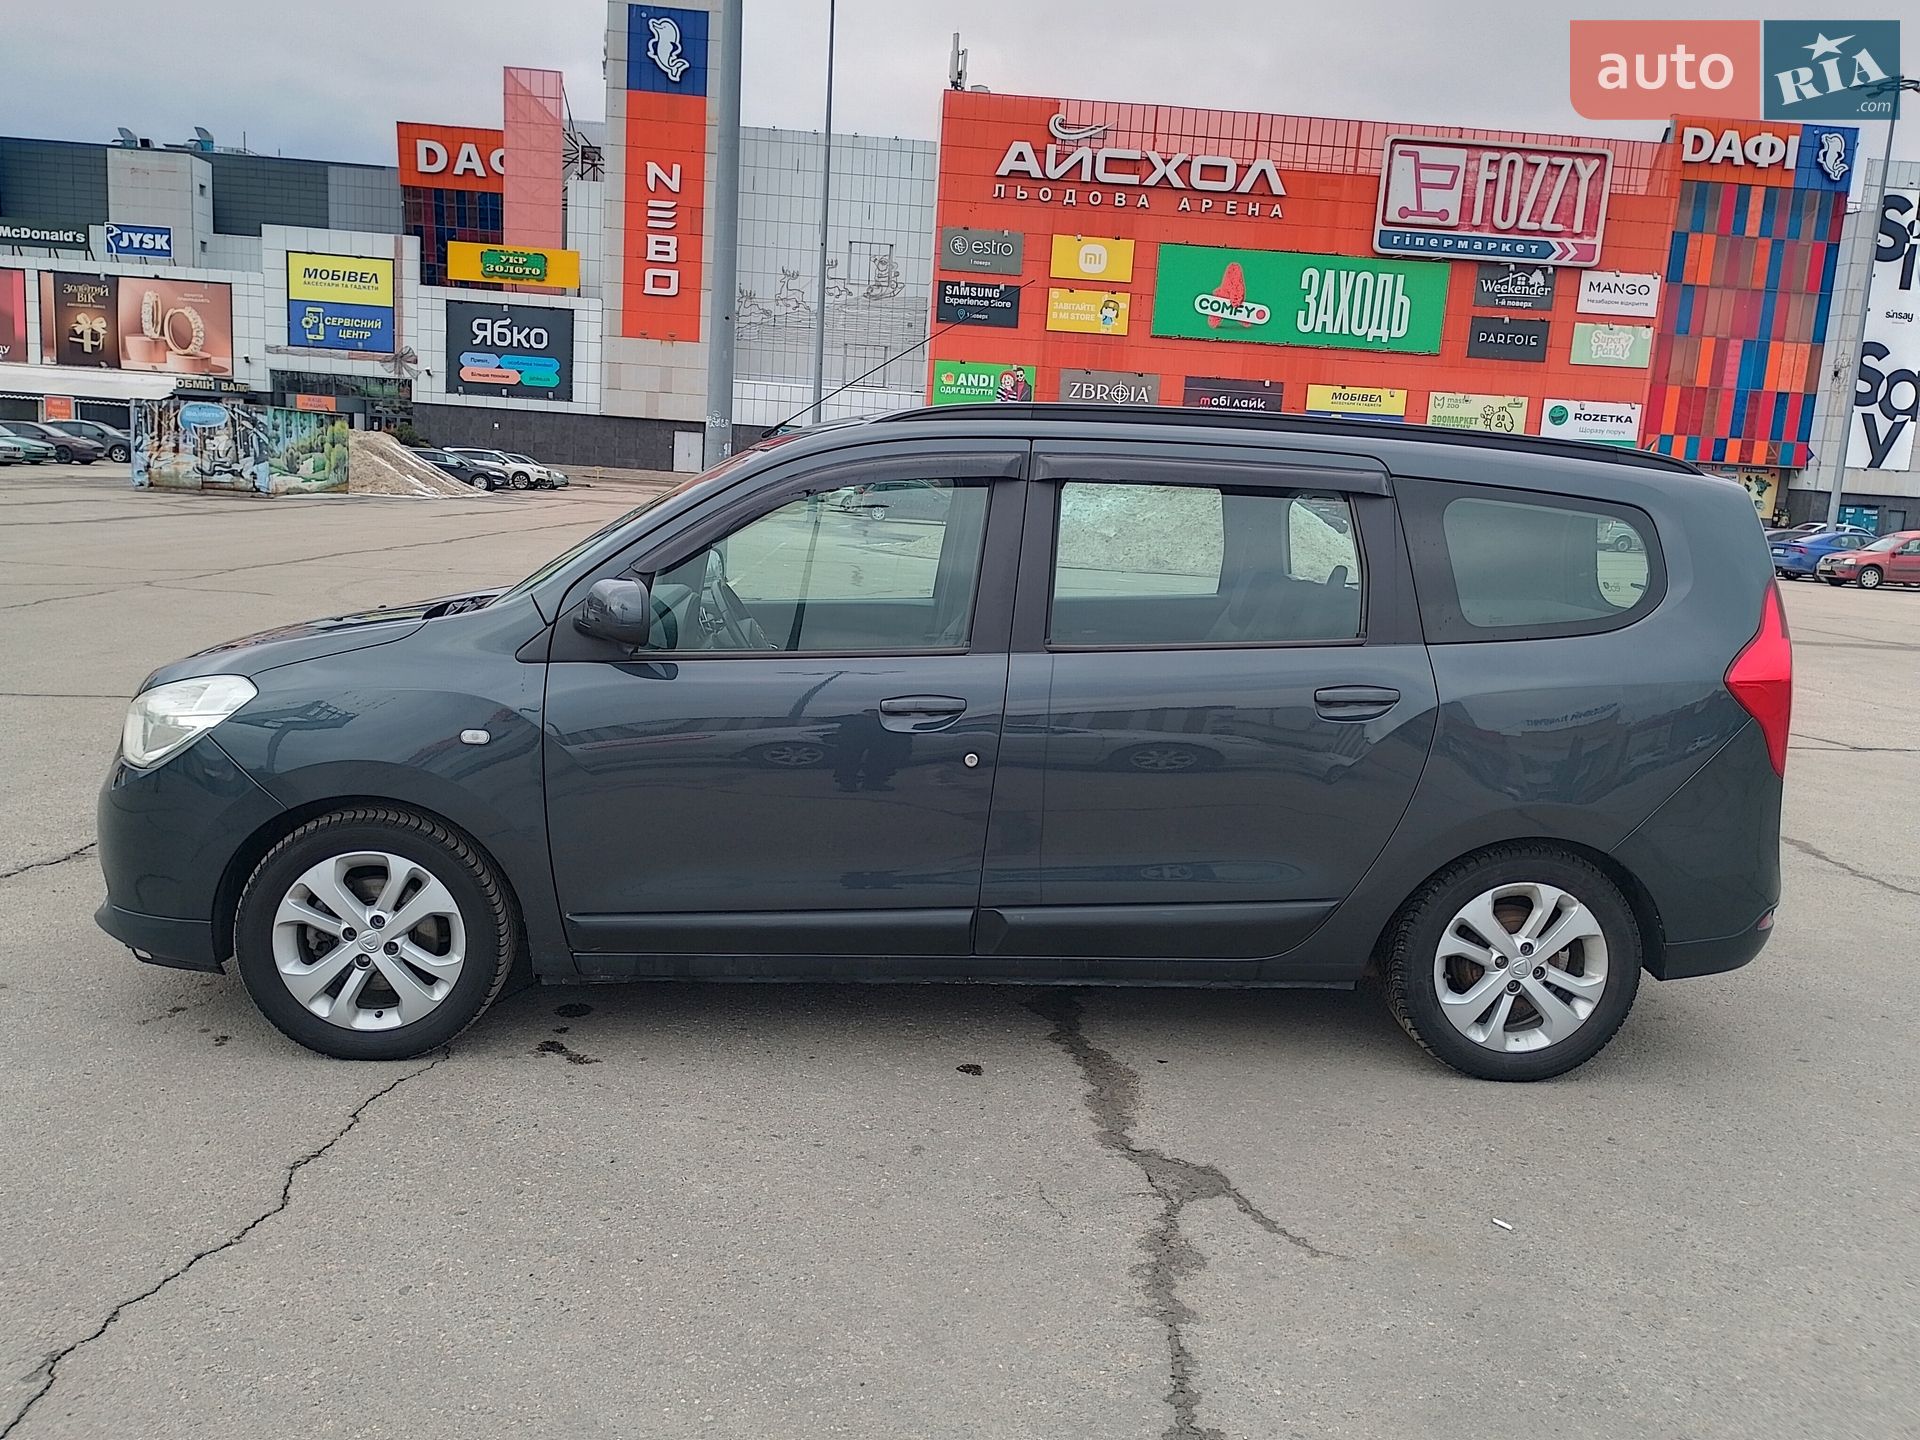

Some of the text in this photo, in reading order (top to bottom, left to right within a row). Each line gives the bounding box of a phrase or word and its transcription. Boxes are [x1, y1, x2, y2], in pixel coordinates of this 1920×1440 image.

[1471, 151, 1600, 234] FOZZY
[993, 183, 1284, 218] ЛЬОДОВА АРЕНА
[0, 226, 86, 243] McDonald's
[643, 161, 682, 296] NEBO
[119, 231, 171, 250] JYSK
[1392, 234, 1539, 254] гіпермаркет
[971, 240, 1013, 256] estro
[500, 255, 528, 265] УКР
[303, 267, 379, 284] МОБІВЕЛ
[486, 264, 541, 275] ЗОЛОТО
[945, 285, 1000, 298] SAMSUNG
[1481, 276, 1551, 296] Weekender
[1588, 281, 1650, 296] MANGO
[945, 296, 989, 306] Experience
[1053, 302, 1096, 312] ЗАВІТАЙТЕ
[1296, 267, 1412, 343] ЗАХОДЬ
[1507, 300, 1533, 309] поверх
[1199, 298, 1255, 320] COMFY
[1885, 309, 1914, 322] sinsay
[324, 316, 382, 329] СЕРВІСНИЙ
[338, 329, 371, 340] ЦЕНТР
[472, 317, 549, 350] Ябко
[1479, 332, 1538, 346] PARFOIS
[176, 379, 215, 390] ОБМІН
[957, 373, 994, 388] ANDI
[1233, 397, 1266, 409] лайк
[1331, 392, 1382, 402] МОБІВЕЛ
[1432, 415, 1479, 425] ЗООМАРКЕТ
[1574, 412, 1633, 424] ROZETKA
